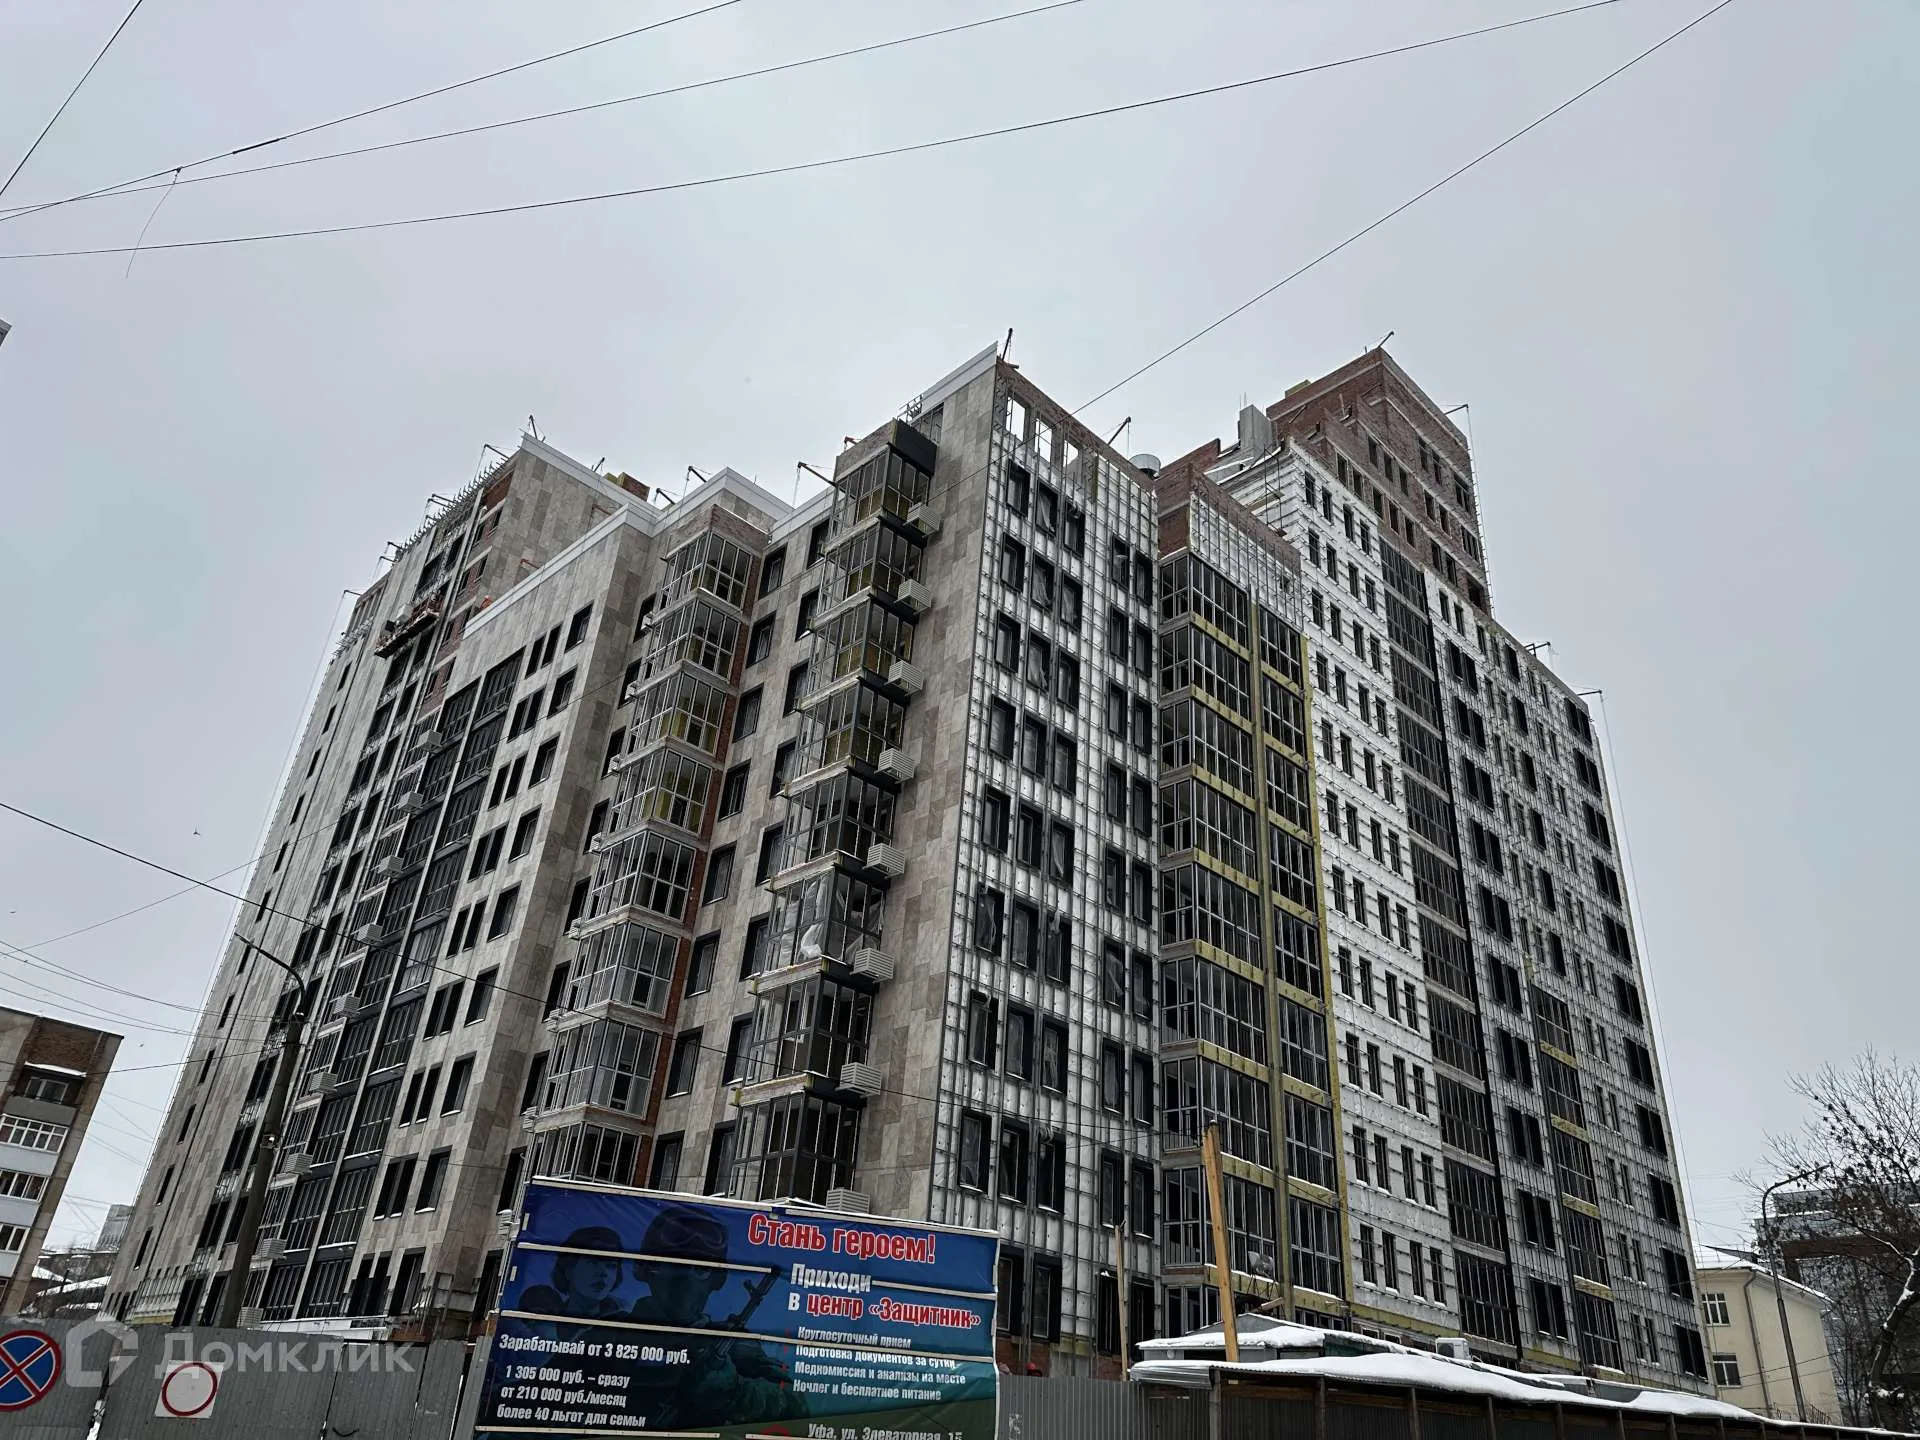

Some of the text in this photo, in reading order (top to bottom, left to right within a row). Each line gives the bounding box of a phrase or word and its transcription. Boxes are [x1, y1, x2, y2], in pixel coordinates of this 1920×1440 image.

[749, 1213, 936, 1264] Стань героем!
[790, 1263, 872, 1293] Приходи
[807, 1293, 863, 1319] центр
[869, 1297, 981, 1329] «Защитник»
[797, 1326, 879, 1345] Круглосуточный
[499, 1334, 691, 1365] Зарабатывай от 3 825 000 руб.
[796, 1346, 853, 1361] Подготовка
[854, 1350, 914, 1366] документов
[915, 1356, 927, 1366] за
[505, 1365, 512, 1378] 1
[515, 1365, 537, 1380] 305
[538, 1367, 560, 1382] 000
[562, 1370, 585, 1384] руб.
[597, 1374, 631, 1389] сразу
[794, 1361, 966, 1384] Медкомиссия и анализы на месте
[500, 1386, 627, 1408] от 210 000 руб./месяц
[793, 1379, 942, 1401] Ночлег и бесплатное питание
[496, 1404, 646, 1427] более 40 льгот для семьи
